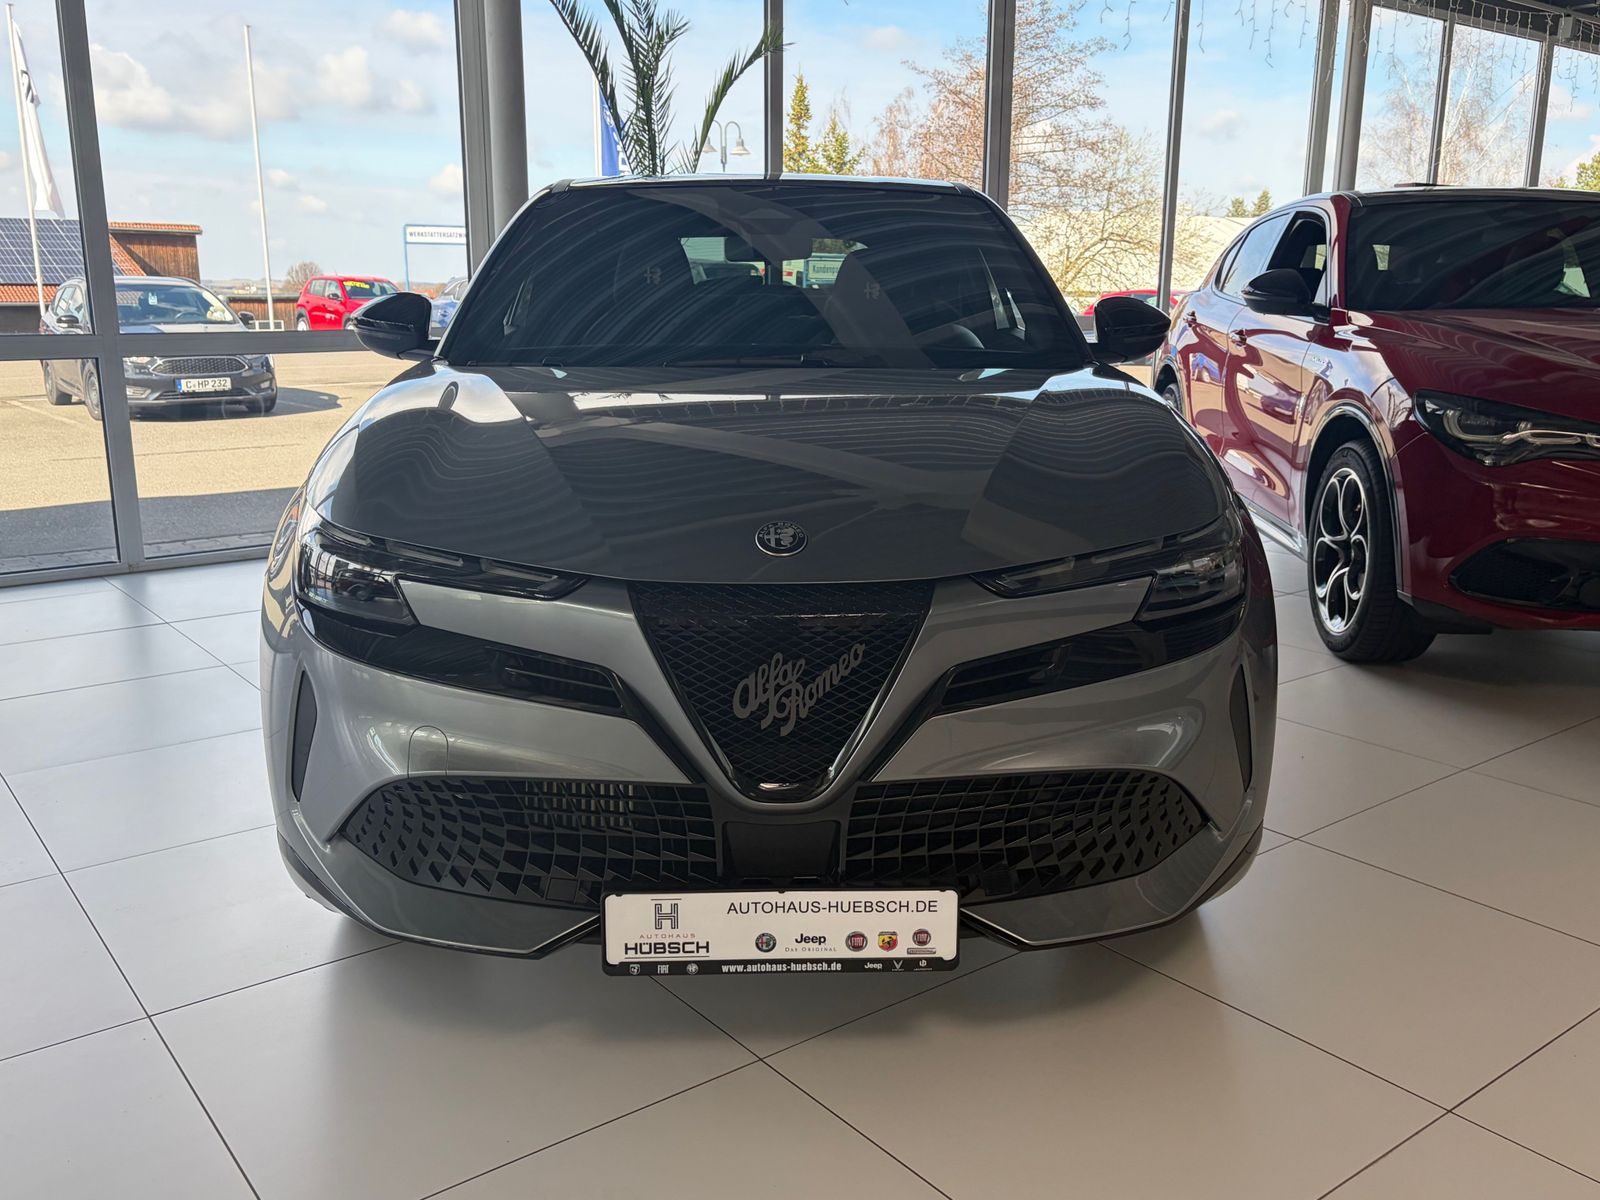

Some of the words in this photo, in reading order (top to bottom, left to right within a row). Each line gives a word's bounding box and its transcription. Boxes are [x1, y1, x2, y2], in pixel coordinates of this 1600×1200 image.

[198, 380, 209, 388] HP
[211, 379, 228, 388] 232
[733, 652, 806, 730] Alfa
[774, 643, 866, 736] Romeo
[727, 900, 938, 914] AUTOHAUS-HUEBSCH.DE
[795, 933, 827, 945] Jeep
[624, 941, 710, 955] HÜBSCH
[657, 964, 669, 974] FIAT
[721, 962, 842, 973] www.autohaus-huebsch.de
[864, 962, 883, 971] Jeep
